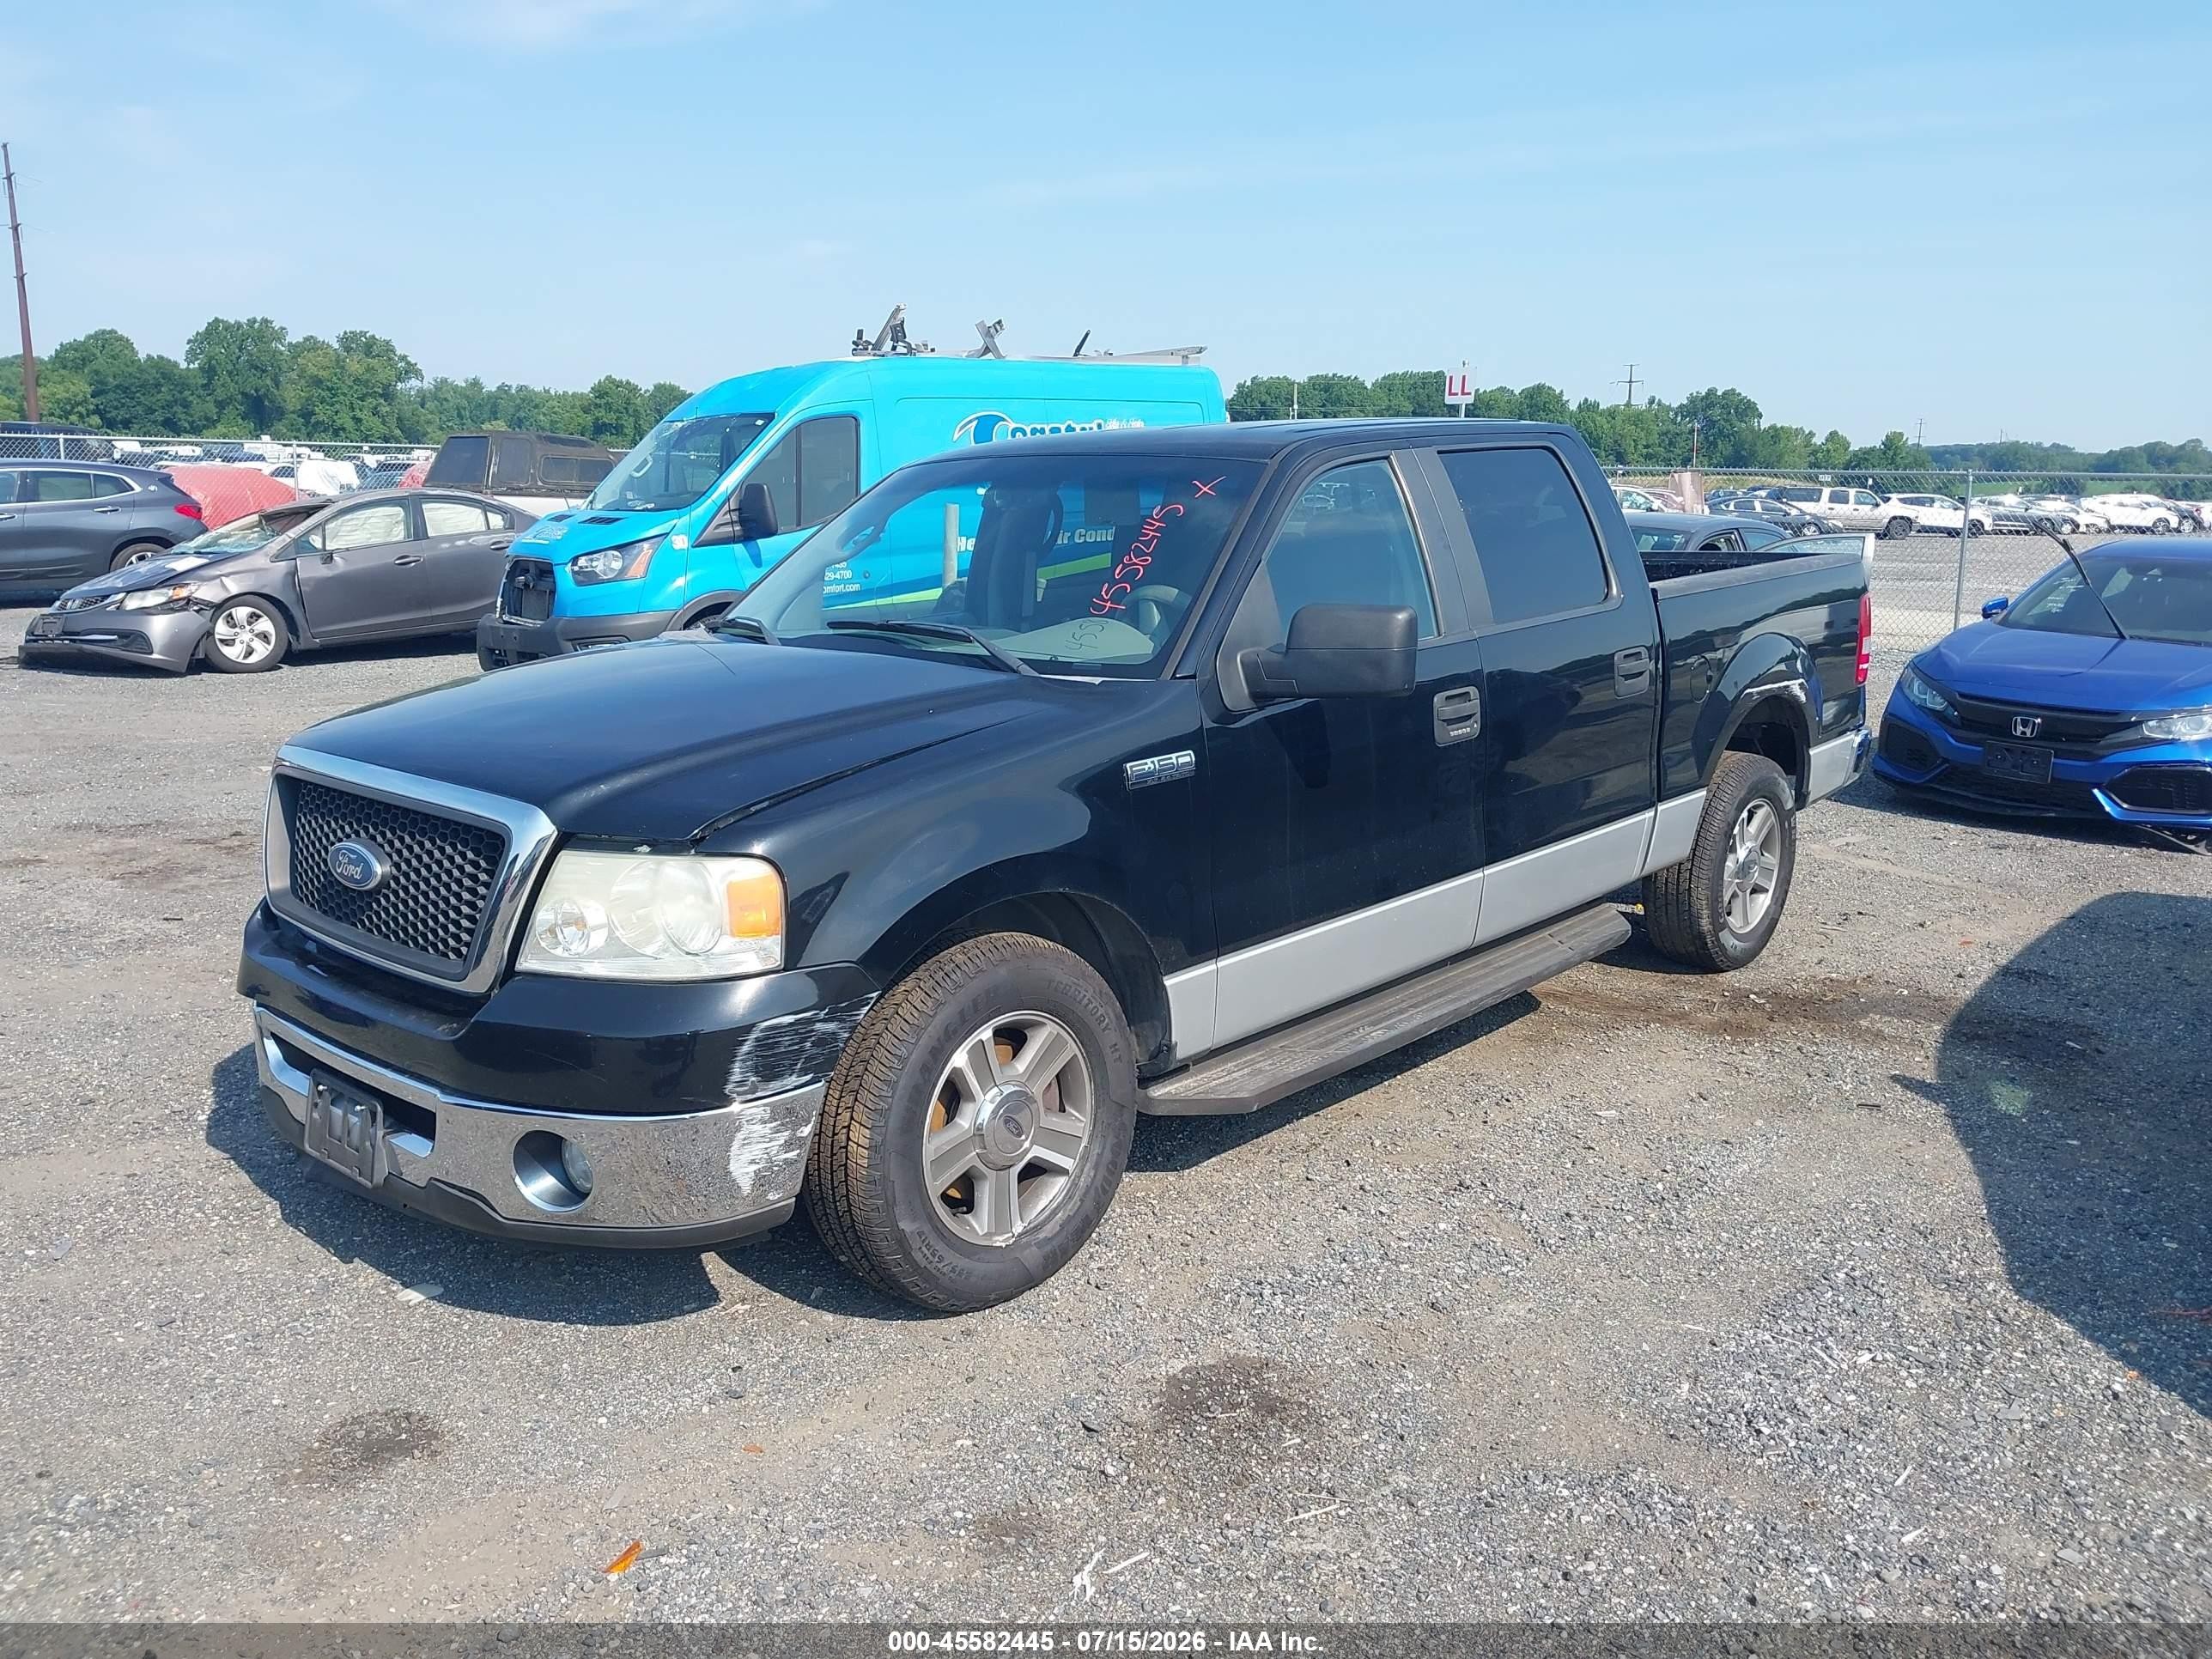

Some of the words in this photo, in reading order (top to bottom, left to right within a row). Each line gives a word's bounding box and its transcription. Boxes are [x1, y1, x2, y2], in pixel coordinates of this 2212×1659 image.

[1447, 374, 1473, 396] LL
[1089, 503, 1184, 615] 45582445
[335, 849, 365, 880] Ford
